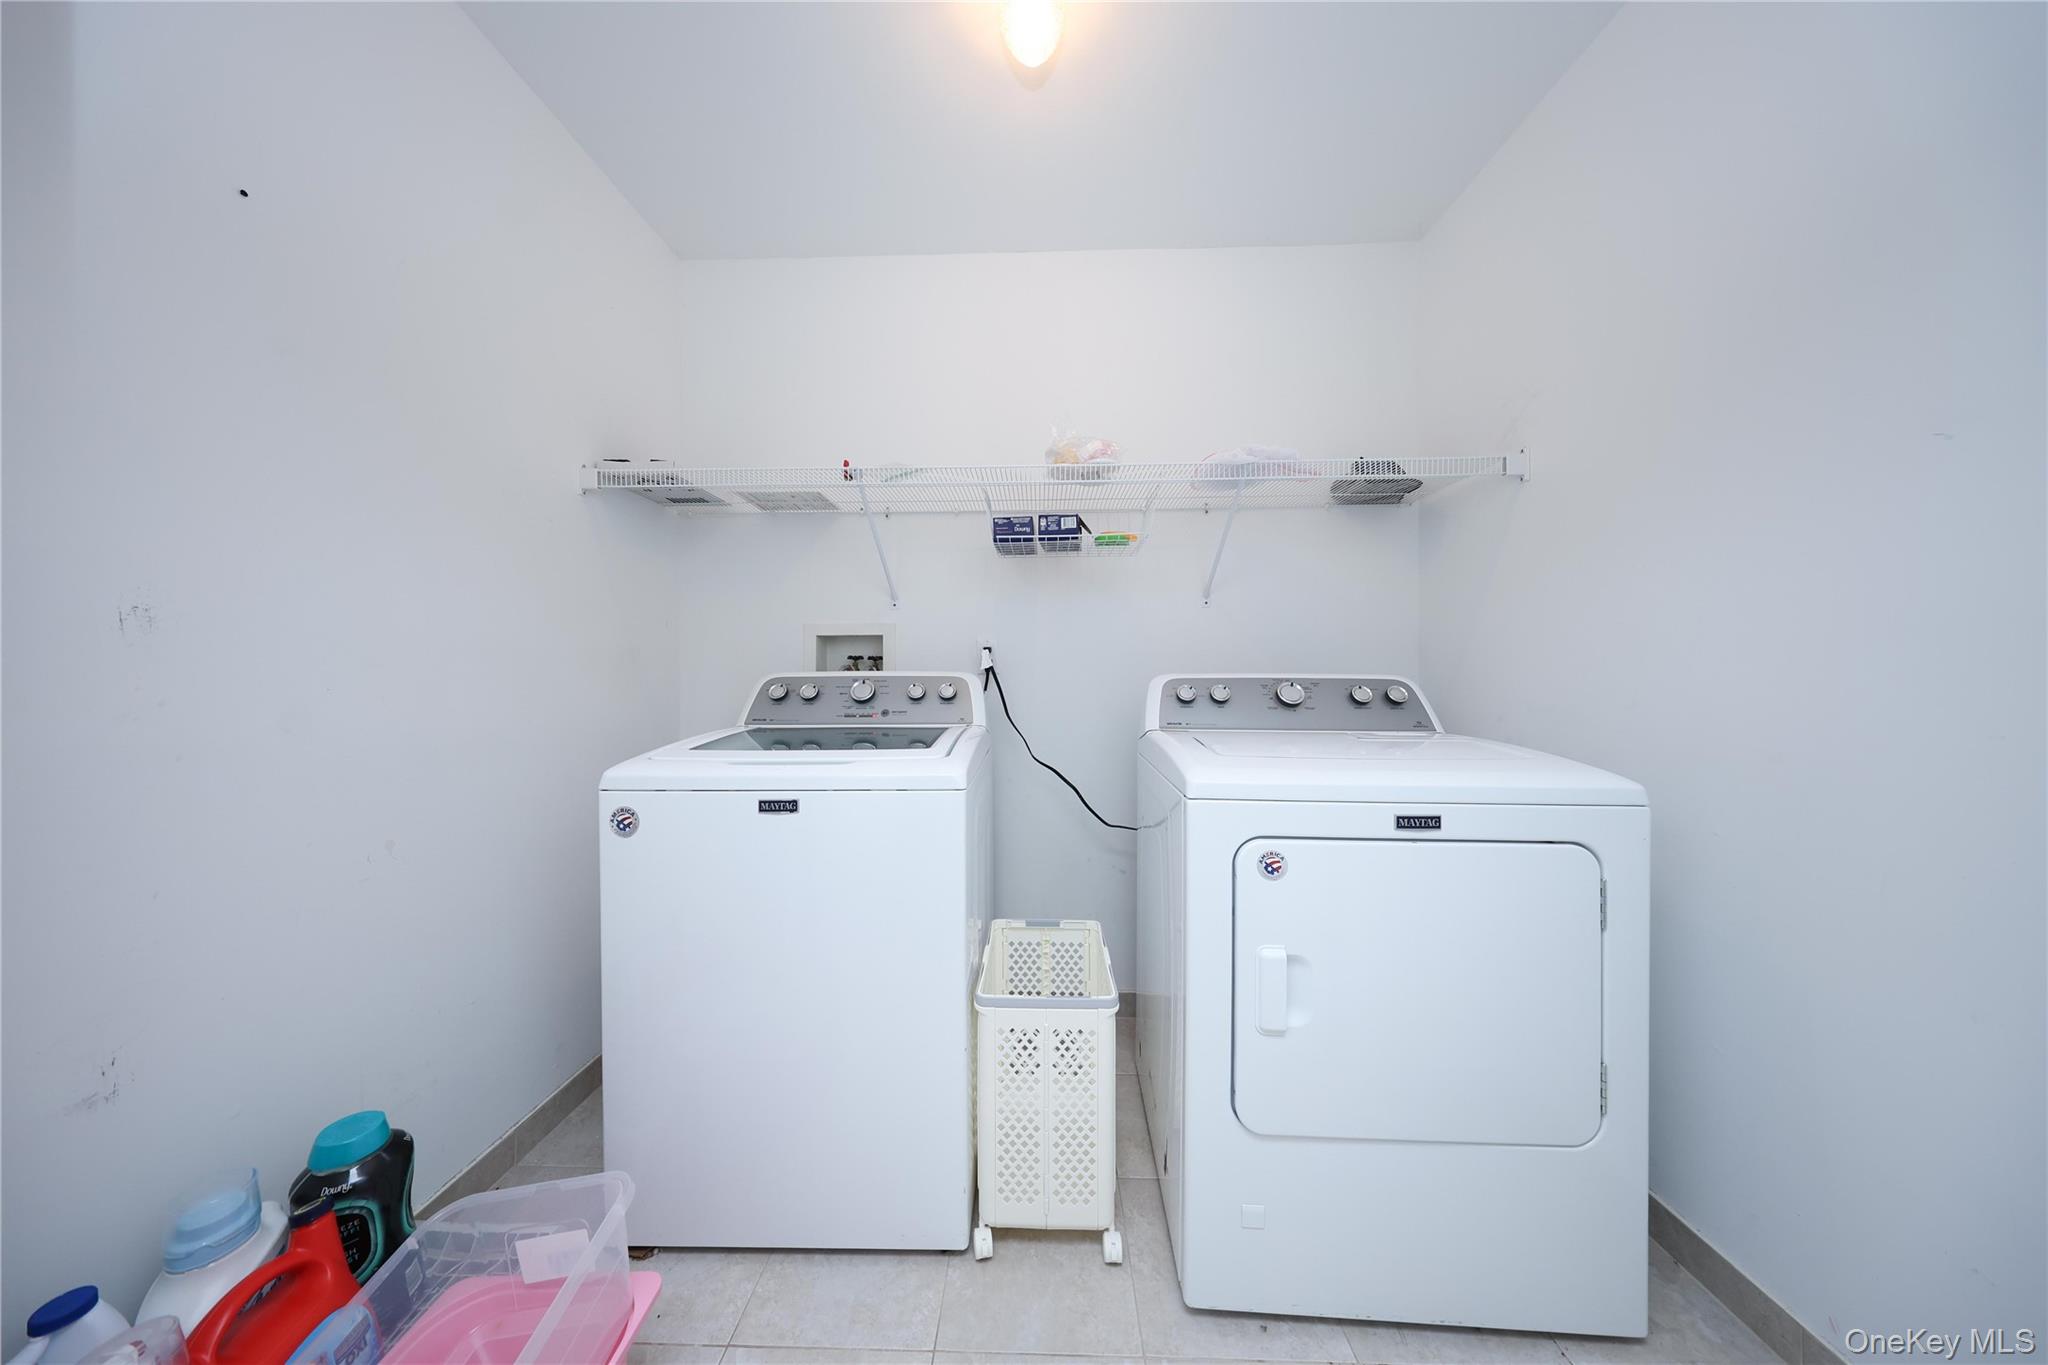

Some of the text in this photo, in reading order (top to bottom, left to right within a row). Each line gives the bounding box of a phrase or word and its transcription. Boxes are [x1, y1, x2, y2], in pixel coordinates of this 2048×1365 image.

[760, 802, 796, 810] MAYTAG
[1398, 818, 1440, 827] MAYTAG
[1259, 851, 1285, 864] AMERICA
[320, 1183, 351, 1197] Downy
